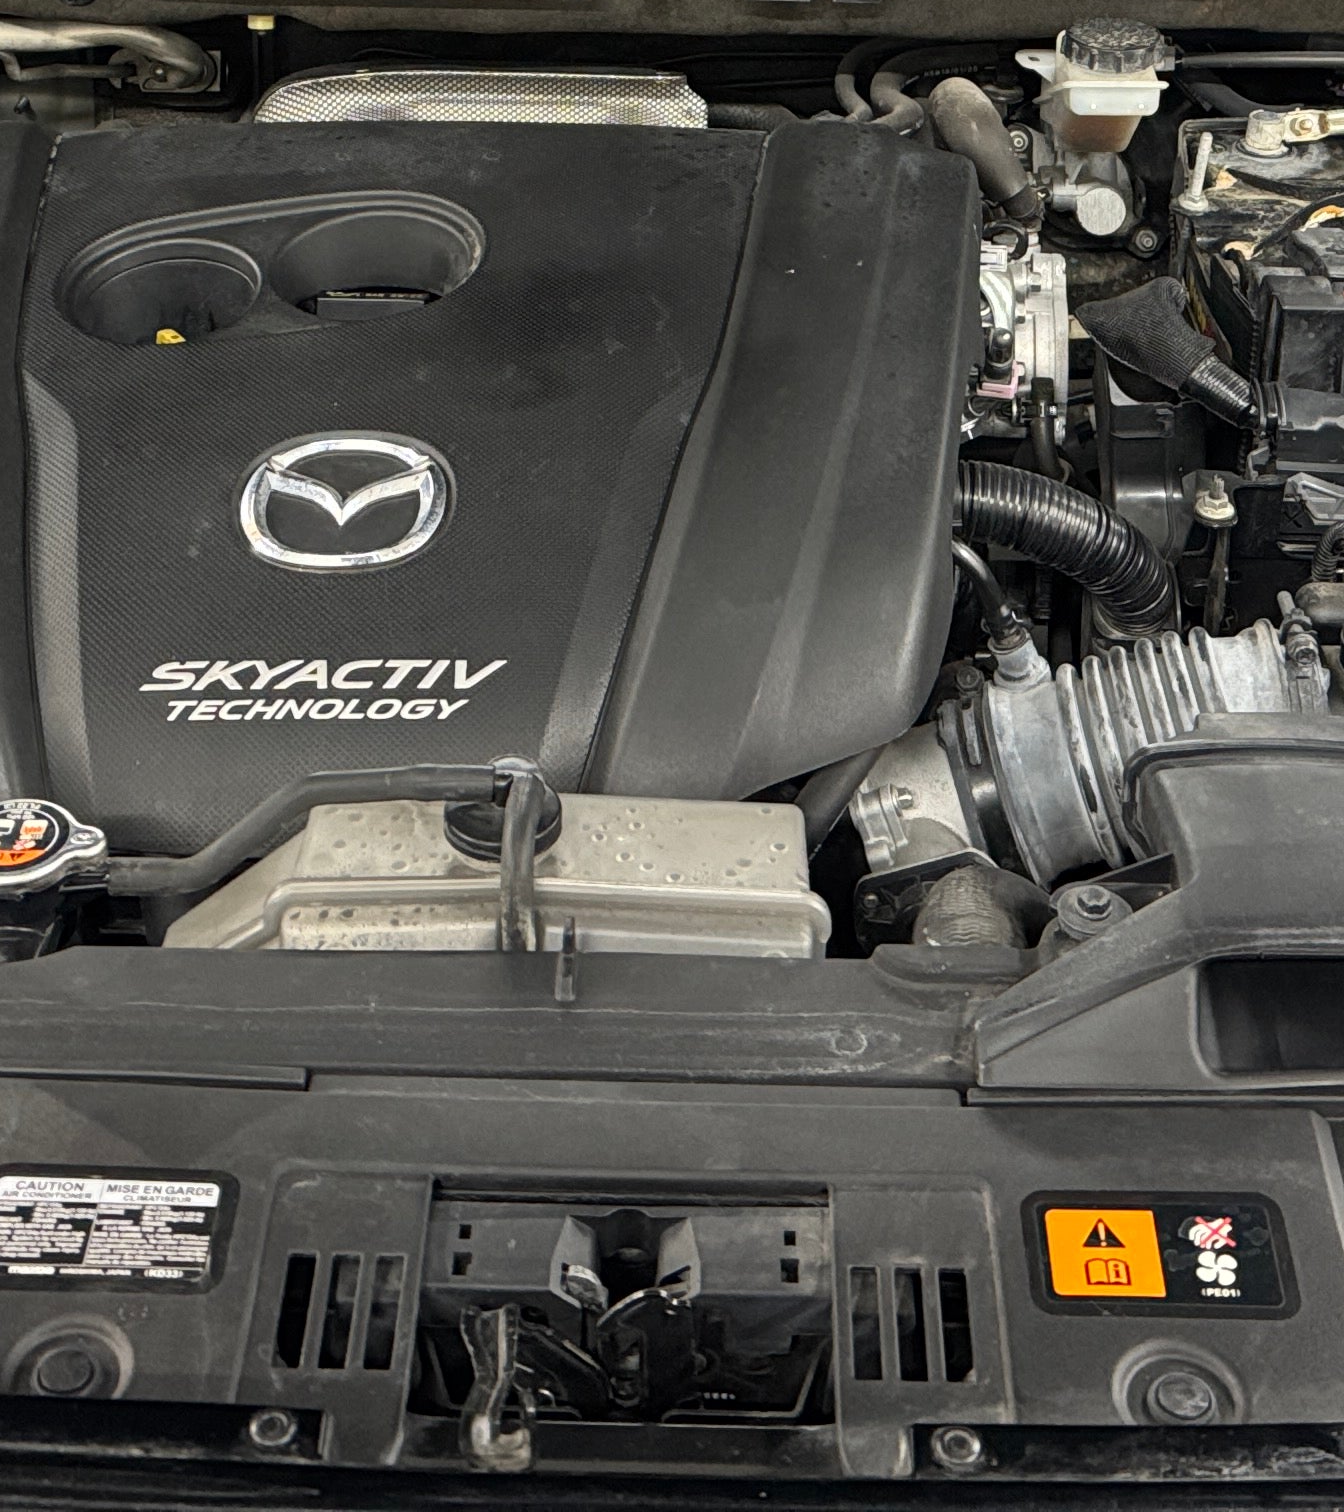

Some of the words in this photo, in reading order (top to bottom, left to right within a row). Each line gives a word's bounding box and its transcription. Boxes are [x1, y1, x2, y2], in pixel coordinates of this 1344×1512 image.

[139, 659, 507, 691] SKYACTIV
[167, 699, 469, 721] TECHNOLOGY
[16, 1180, 85, 1192] CAUTION
[106, 1184, 140, 1194] MISE
[143, 1185, 163, 1195] EN
[165, 1186, 215, 1197] GARDE
